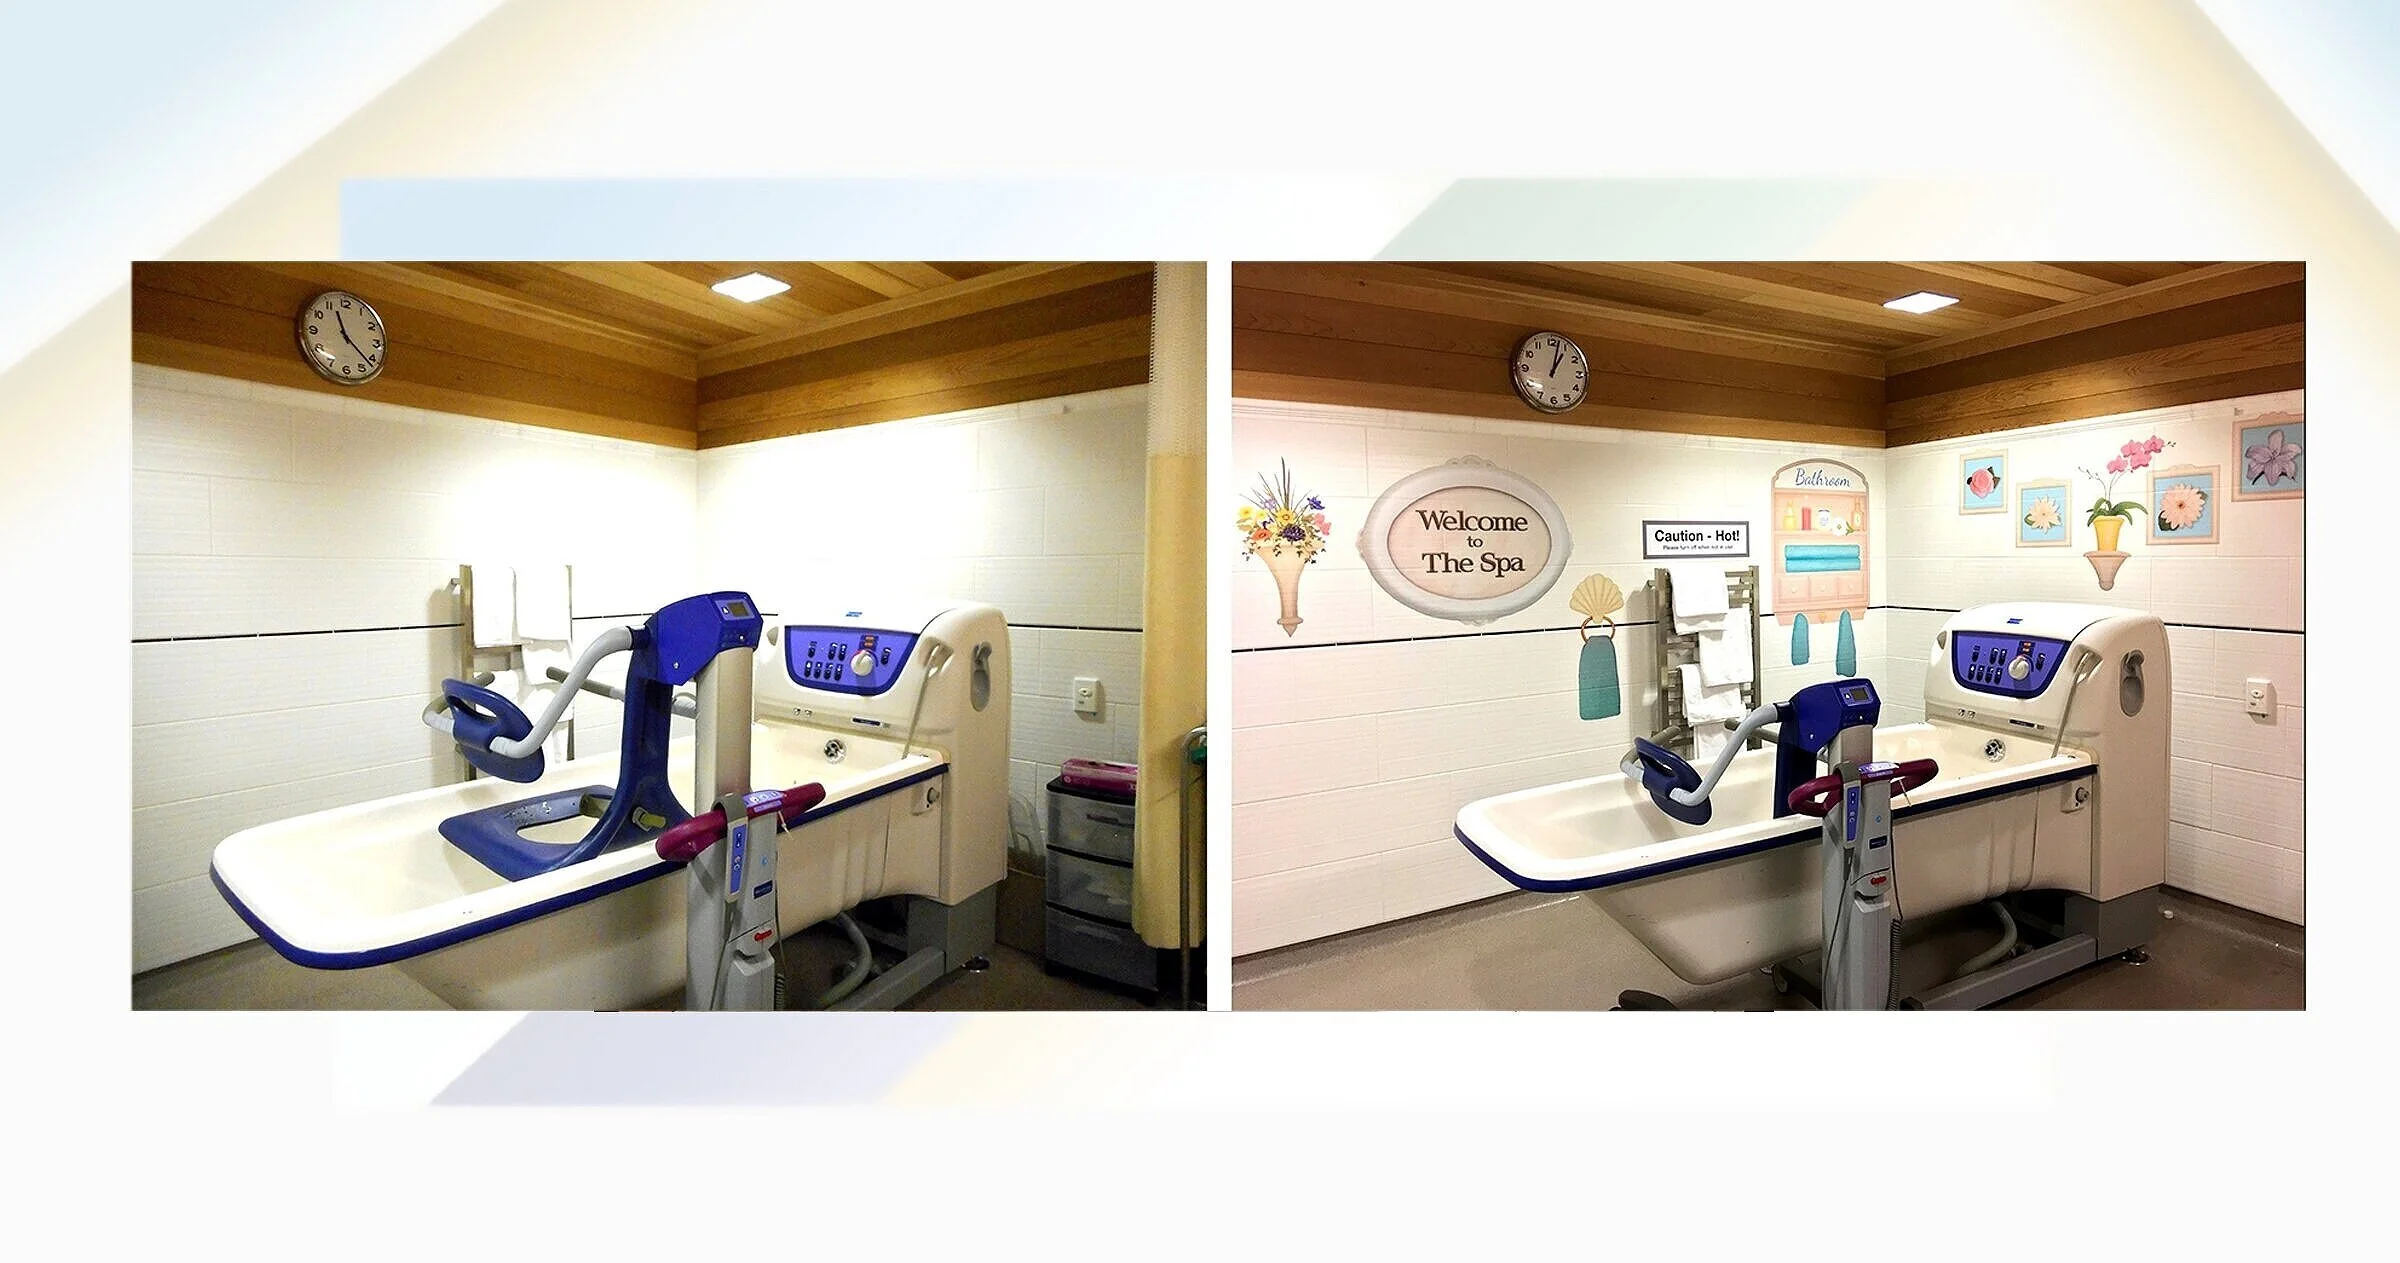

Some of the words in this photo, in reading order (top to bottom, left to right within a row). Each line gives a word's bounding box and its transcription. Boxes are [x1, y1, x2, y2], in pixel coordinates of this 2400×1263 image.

[326, 301, 332, 310] 11
[341, 299, 352, 309] 12
[314, 310, 324, 319] 10
[308, 325, 318, 335] 9
[368, 322, 376, 331] 2
[372, 339, 381, 349] 3
[1535, 341, 1541, 350] 11
[1547, 338, 1557, 347] 12
[369, 354, 376, 363] 4
[1525, 350, 1534, 359] 10
[327, 357, 335, 367] 7
[1571, 356, 1579, 364] 2
[342, 365, 351, 375] 6
[358, 363, 367, 372] 5
[1521, 364, 1530, 372] 9
[1575, 370, 1584, 379] 3
[1572, 384, 1580, 392] 4
[1537, 391, 1544, 400] 7
[1563, 394, 1571, 402] 5
[1550, 396, 1558, 405] 6
[1795, 467, 1850, 487] Bathroom
[1415, 510, 1528, 532] Welcome
[1654, 529, 1704, 542] Caution
[1715, 530, 1740, 541] Hot!
[1467, 536, 1483, 548] to
[1422, 551, 1474, 574] The
[1480, 552, 1526, 578] Spa
